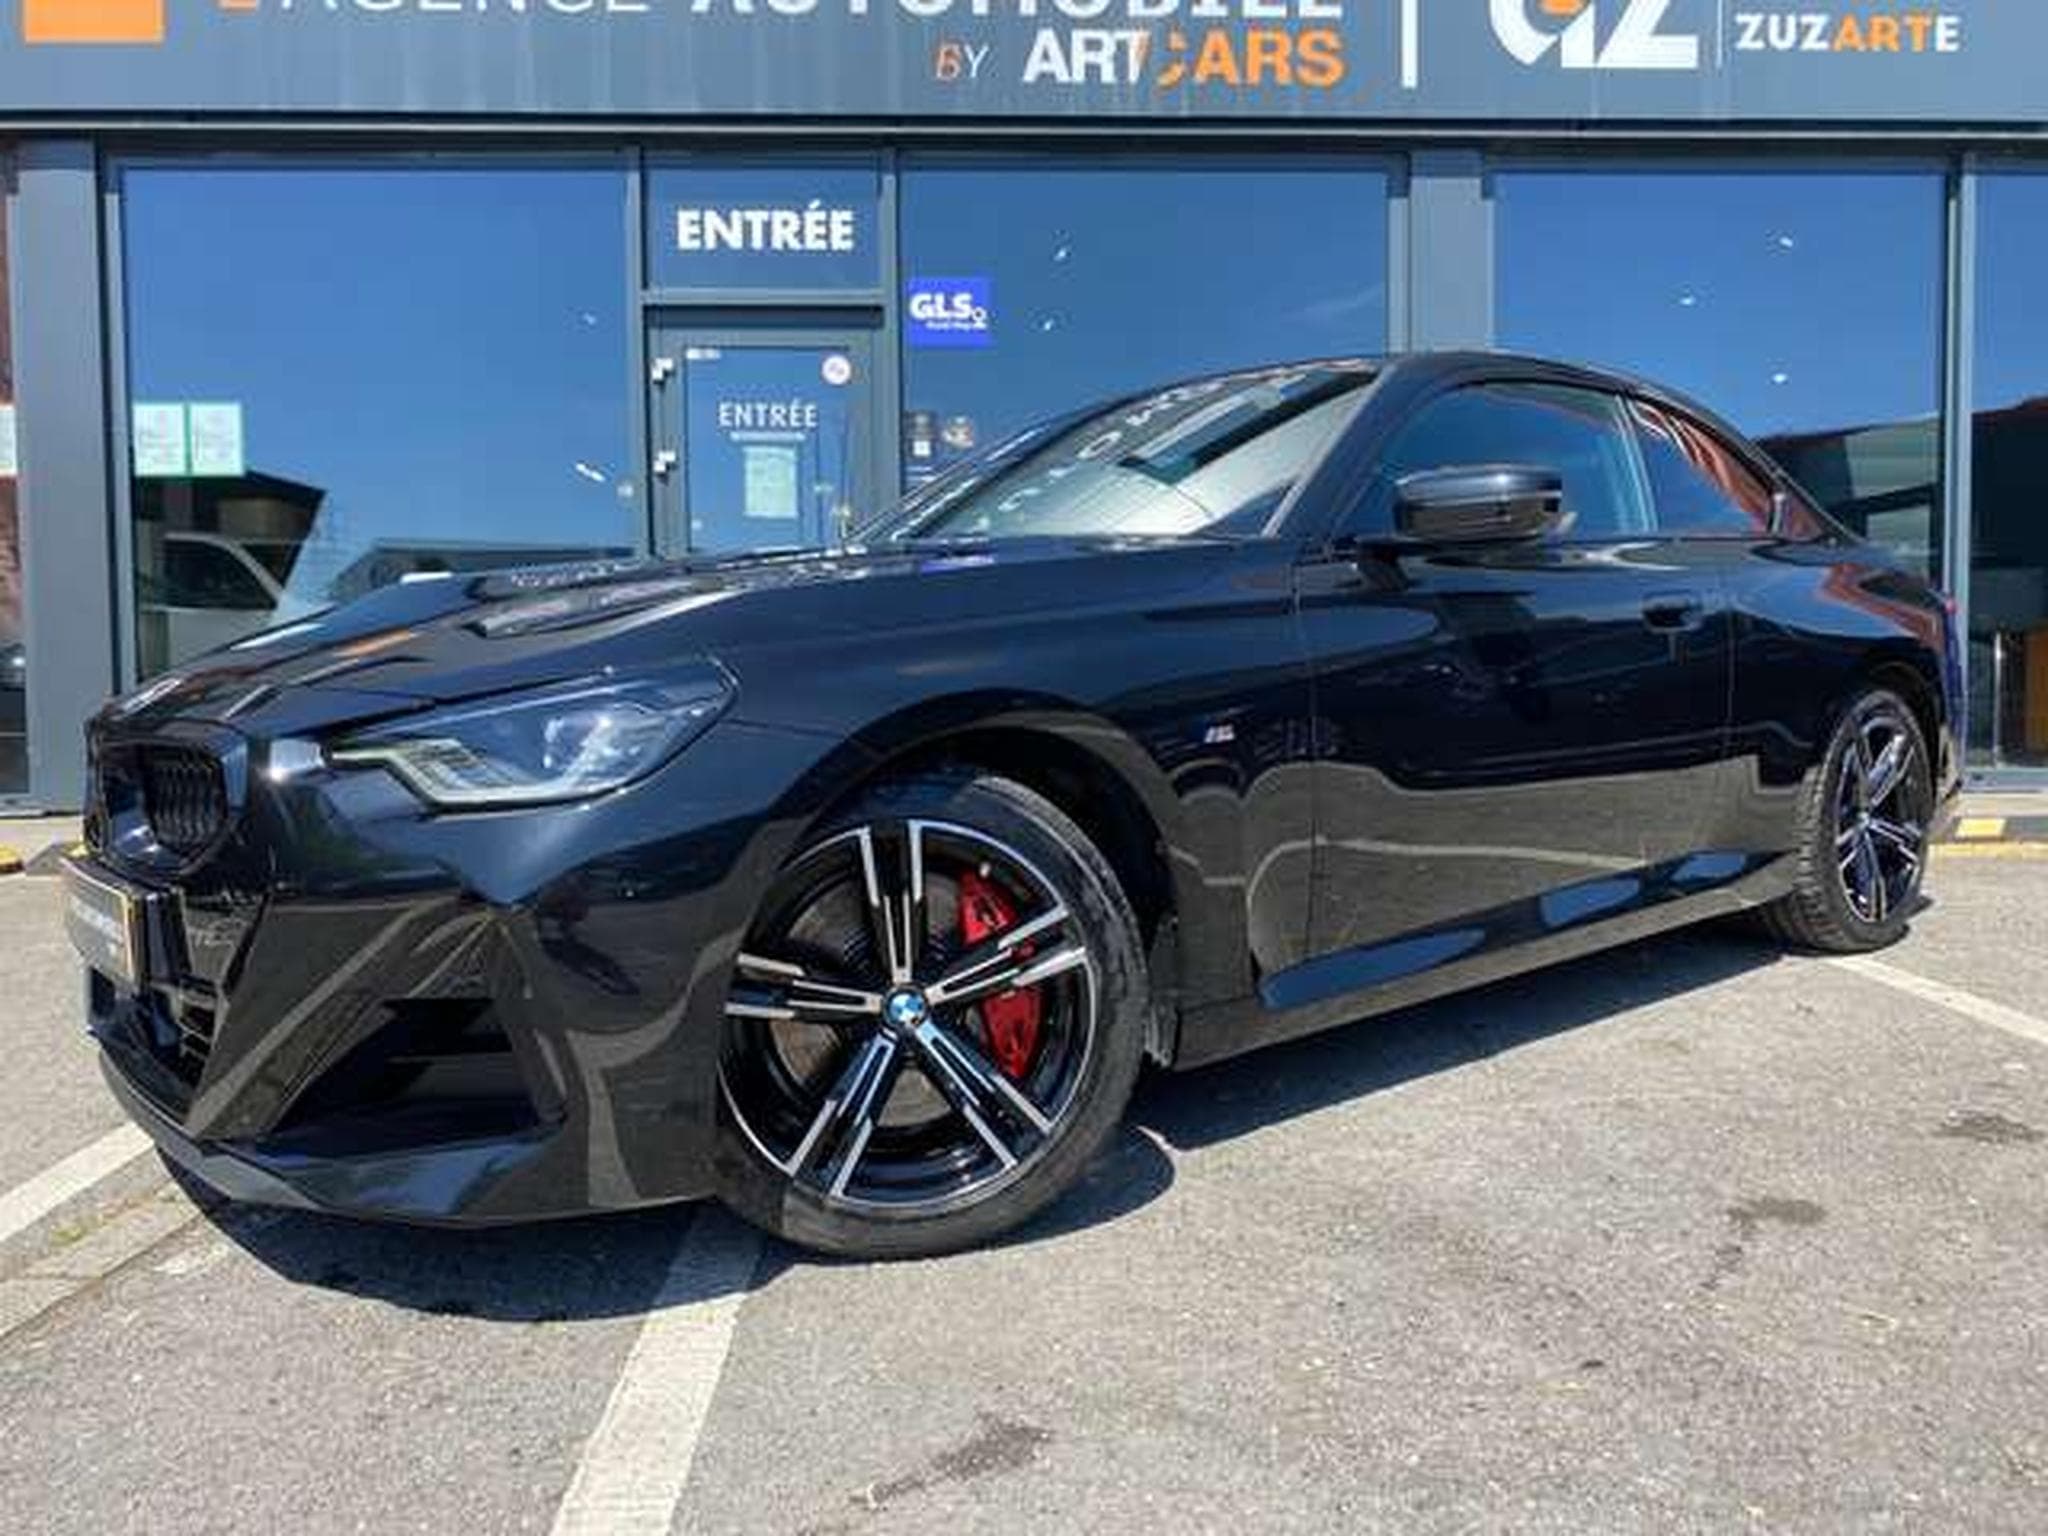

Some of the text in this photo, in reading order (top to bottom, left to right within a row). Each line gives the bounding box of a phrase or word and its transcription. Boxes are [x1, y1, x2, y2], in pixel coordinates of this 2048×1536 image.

[1735, 13, 1960, 51] ZUZARTE
[677, 199, 854, 250] ENTRÉE
[910, 292, 972, 319] GLS
[718, 398, 818, 428] ENTRÉE
